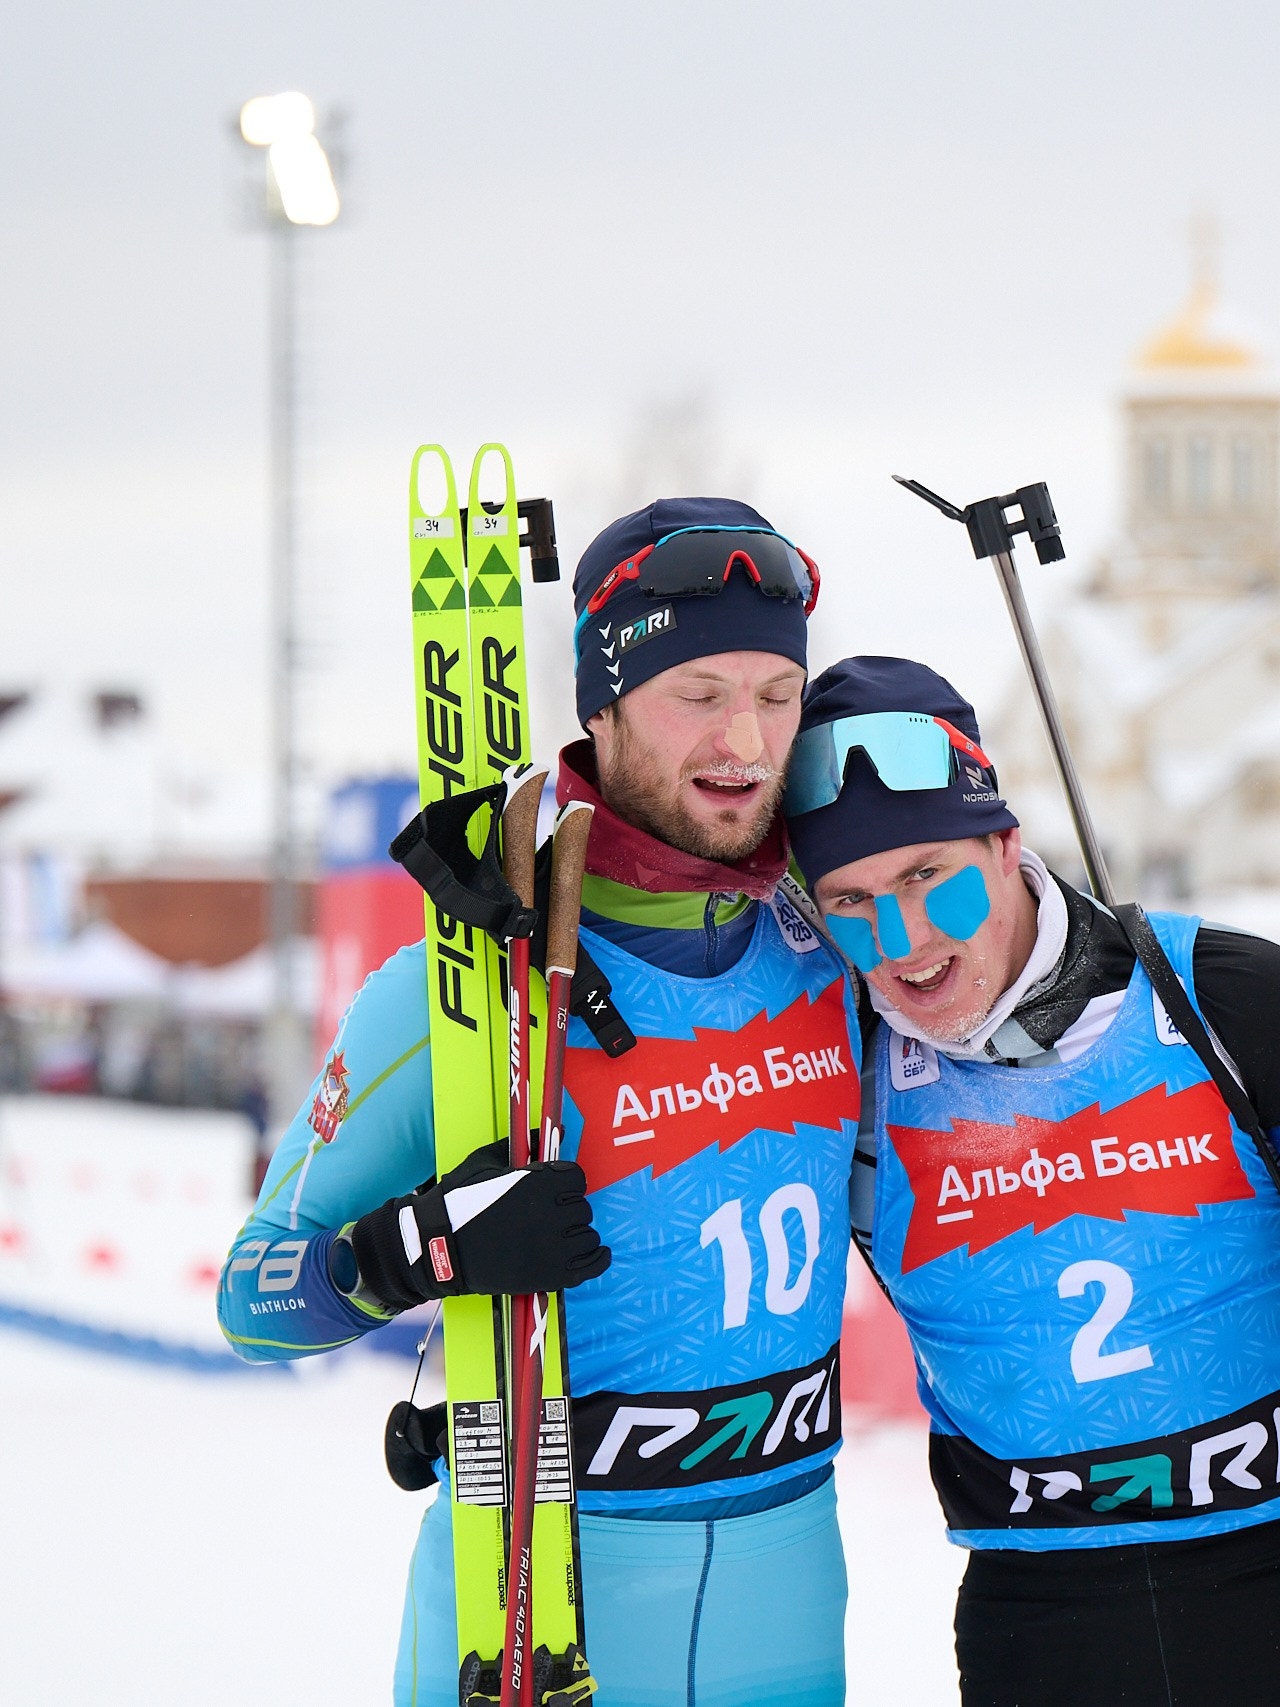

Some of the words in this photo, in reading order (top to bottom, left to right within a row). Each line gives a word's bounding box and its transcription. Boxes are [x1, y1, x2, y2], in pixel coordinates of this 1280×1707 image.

[425, 519, 439, 532] 34
[484, 517, 498, 529] 34
[612, 1062, 764, 1128] Альфа
[763, 1045, 848, 1090] Банк
[903, 1064, 926, 1078] СБР
[936, 1147, 1085, 1207] Альфа
[1091, 1133, 1220, 1178] Банк
[701, 1183, 820, 1330] 10
[249, 1297, 306, 1315] BIATHLON
[1057, 1260, 1154, 1384] 2
[518, 1547, 530, 1604] TRIAC
[511, 1636, 524, 1690] AERO
